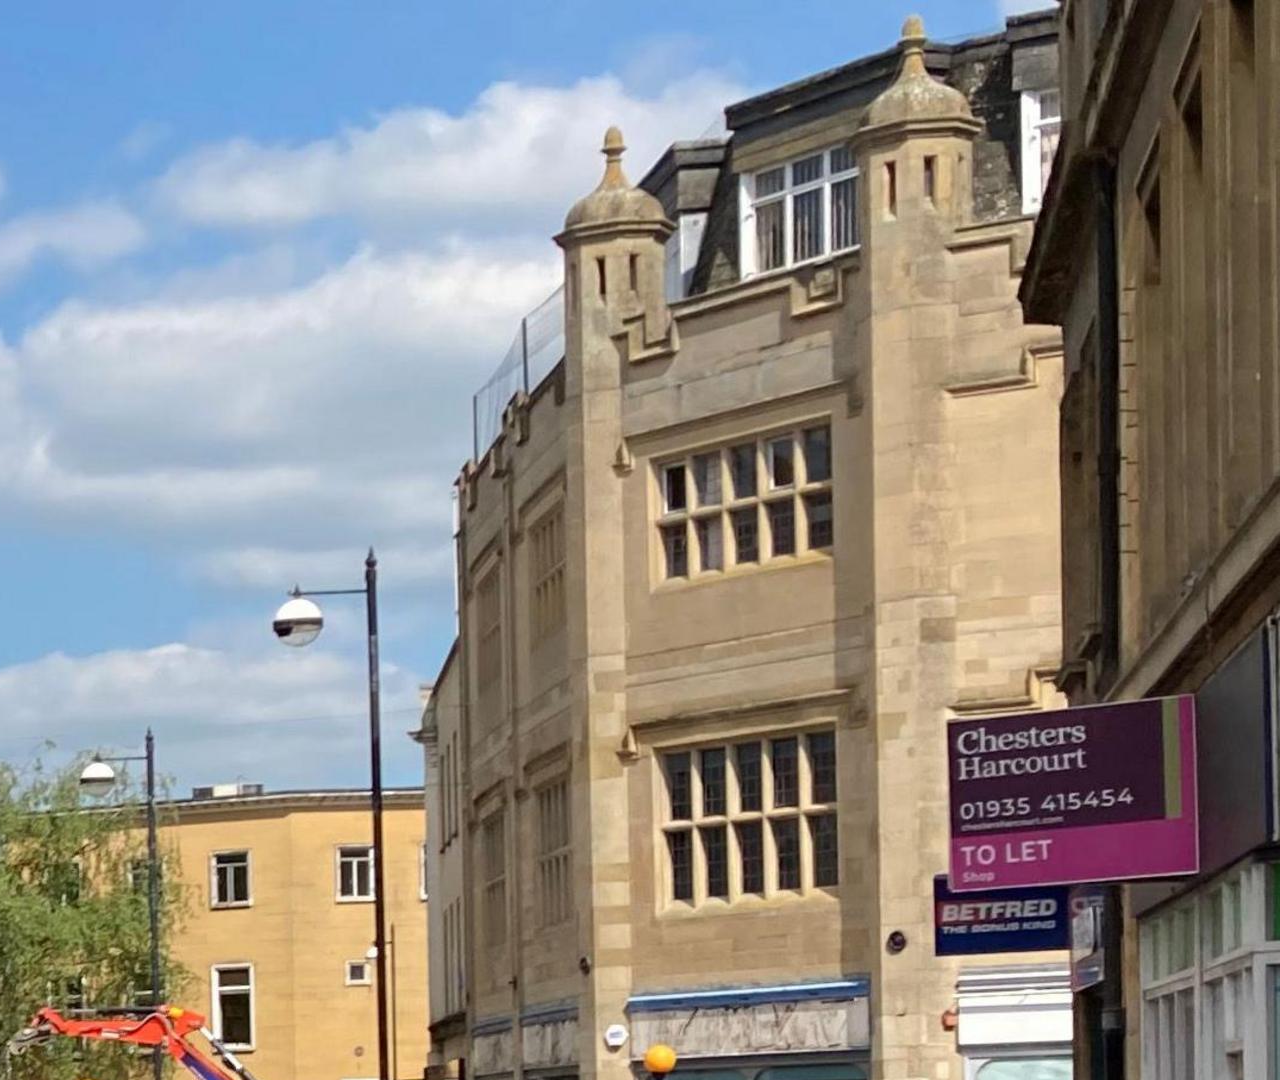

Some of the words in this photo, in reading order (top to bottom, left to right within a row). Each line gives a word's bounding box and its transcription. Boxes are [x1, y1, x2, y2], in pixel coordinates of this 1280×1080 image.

[957, 725, 1087, 756] Chesters
[957, 749, 1087, 780] Harcourt
[960, 797, 1031, 820] 01935
[1040, 787, 1134, 812] 415454
[960, 845, 996, 866] TO
[1005, 839, 1053, 863] LET
[942, 899, 1058, 923] BETFRED
[943, 925, 968, 934] THE
